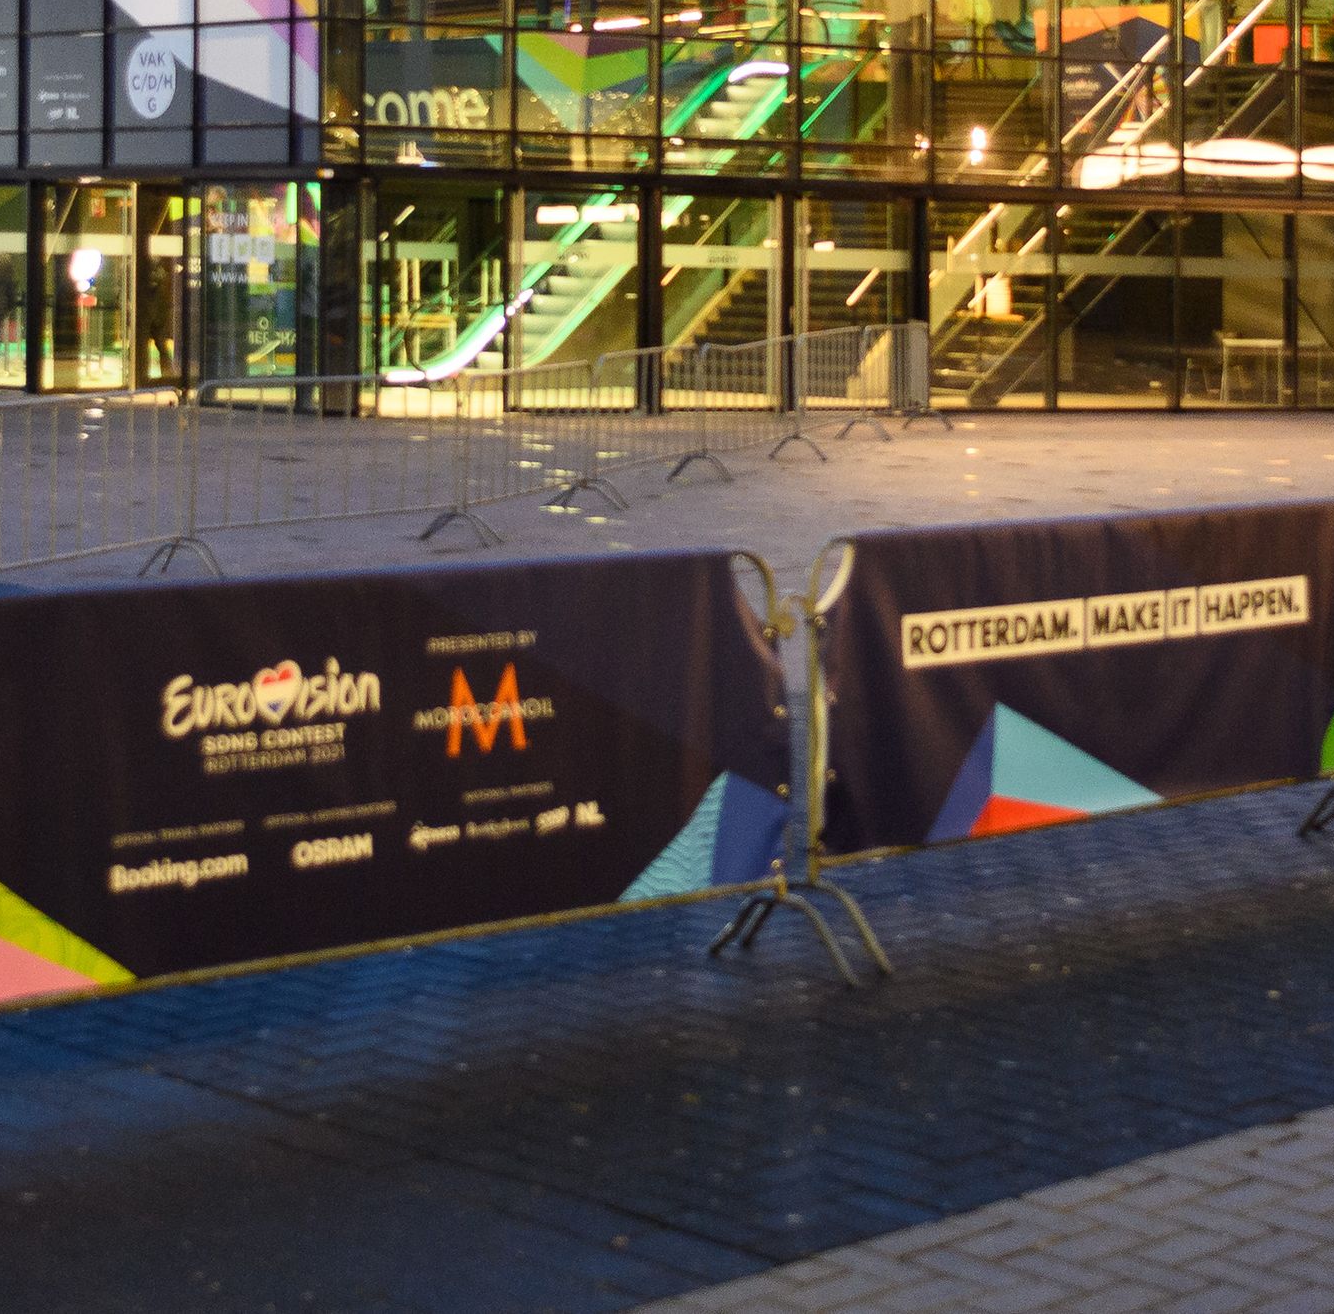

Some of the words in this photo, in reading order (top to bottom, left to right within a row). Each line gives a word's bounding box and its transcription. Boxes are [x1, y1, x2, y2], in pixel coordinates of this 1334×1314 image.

[139, 52, 166, 67] VAK
[131, 75, 174, 92] C/D/H
[147, 97, 158, 113] G
[908, 611, 1079, 656] ROTTERDAM.
[1091, 600, 1161, 637] MAKE
[1170, 597, 1191, 628] IT
[1204, 585, 1300, 623] HAPPEN.
[426, 631, 514, 655] PRESENTED
[516, 628, 539, 647] BY
[413, 698, 555, 731] MOROCCANOIL
[200, 731, 258, 757] SONG
[260, 722, 346, 751] CONTEST
[203, 748, 308, 775] ROTTERDAM
[107, 852, 250, 894] Booking.com
[292, 831, 375, 868] OSRAM
